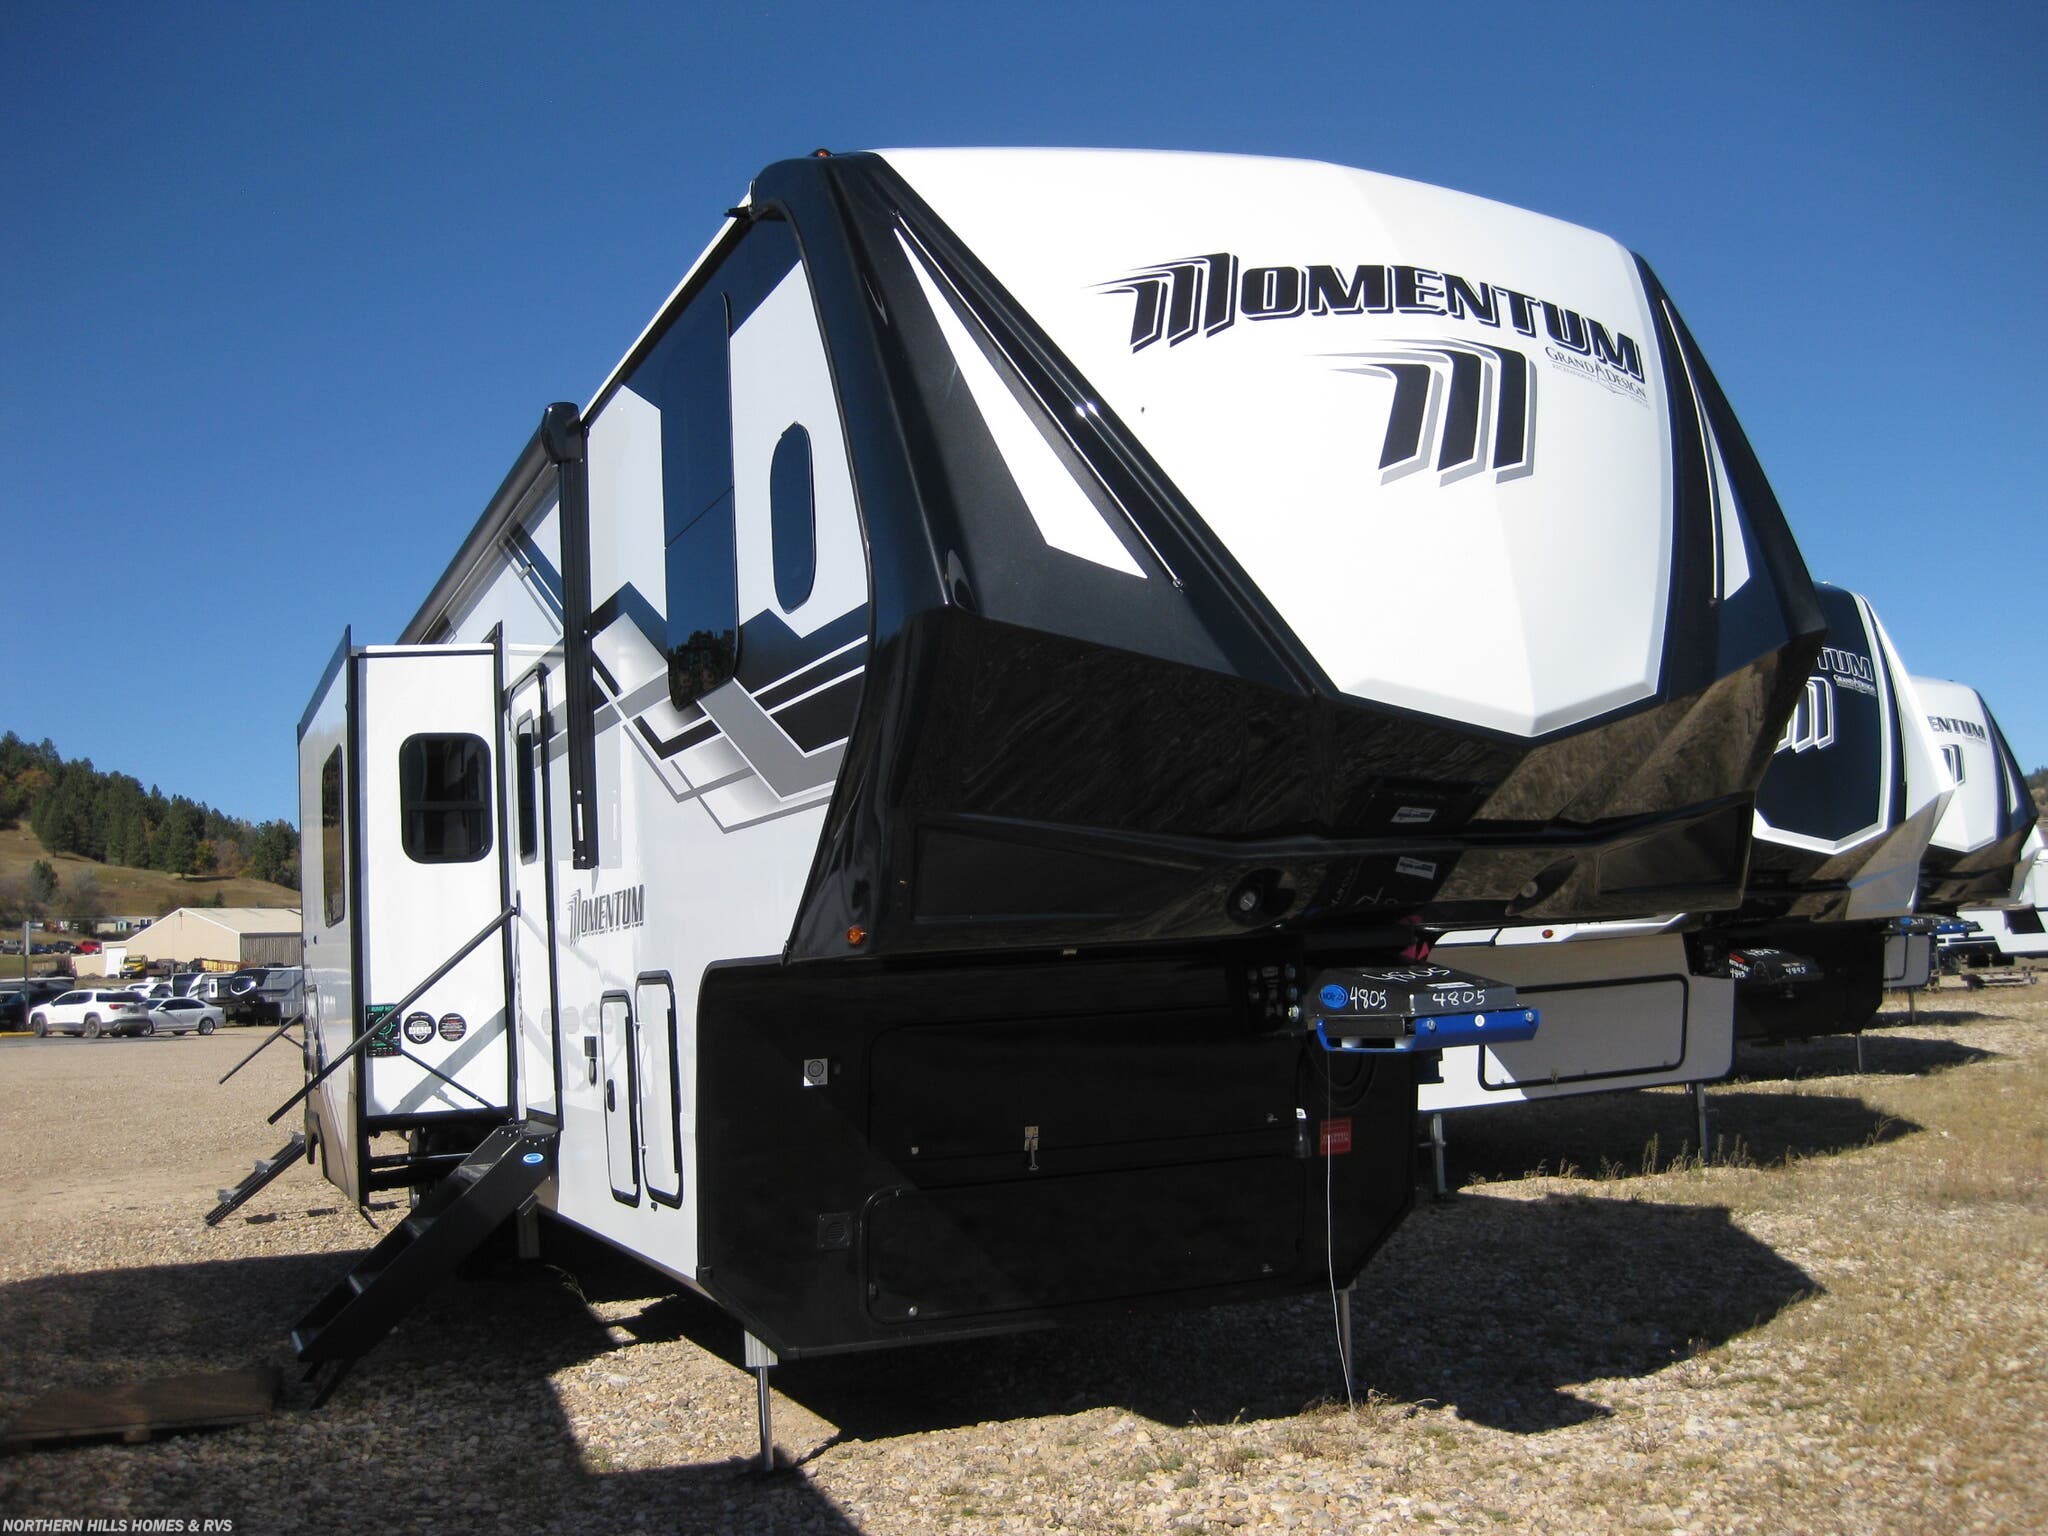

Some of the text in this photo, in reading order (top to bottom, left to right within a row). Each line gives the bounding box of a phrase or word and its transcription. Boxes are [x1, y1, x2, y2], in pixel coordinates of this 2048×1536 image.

[1082, 252, 1646, 385] MOMENTUM
[1545, 346, 1595, 374] GRAND
[1604, 368, 1647, 400] DESIGN
[567, 884, 645, 948] MOMENTUM
[1362, 966, 1450, 983] 4805
[1350, 986, 1387, 1010] 4805
[1432, 989, 1486, 1007] 4805
